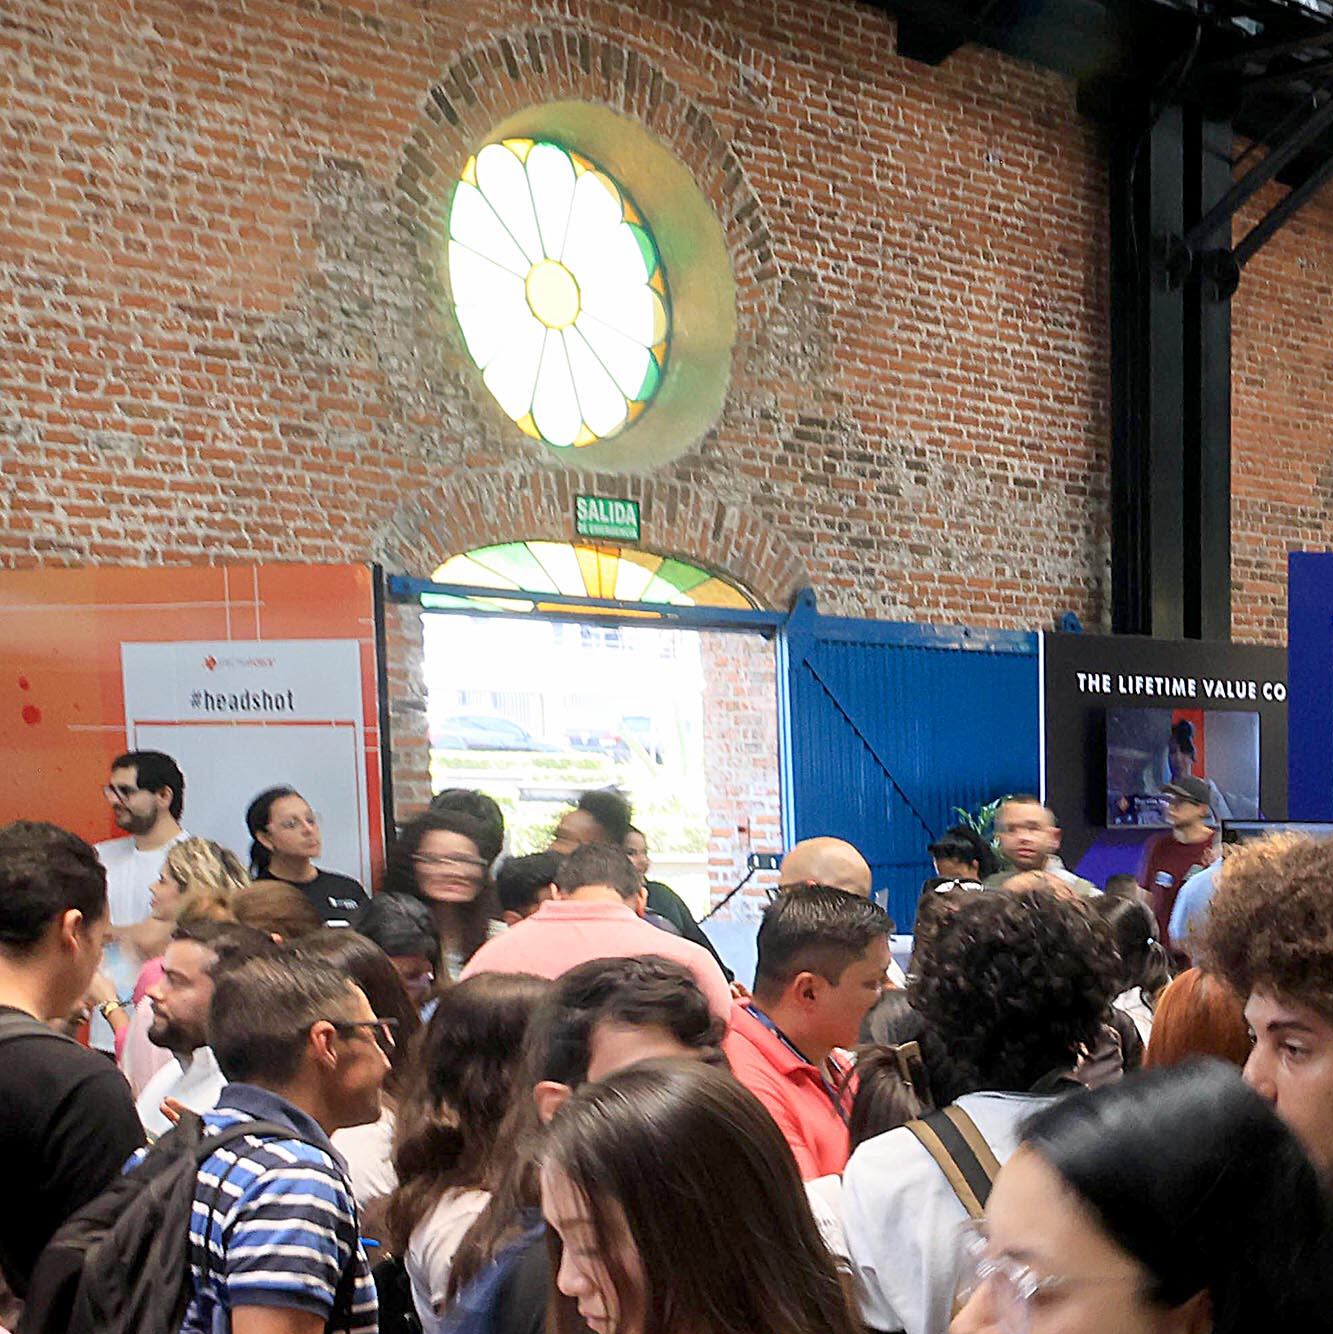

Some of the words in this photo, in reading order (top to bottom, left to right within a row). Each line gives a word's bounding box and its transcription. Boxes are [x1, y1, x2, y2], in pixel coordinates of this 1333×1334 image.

[576, 496, 638, 526] SALIDA
[191, 688, 294, 711] #headshot
[1076, 672, 1111, 693] THE
[1118, 675, 1196, 697] LIFETIME
[1202, 679, 1257, 700] VALUE
